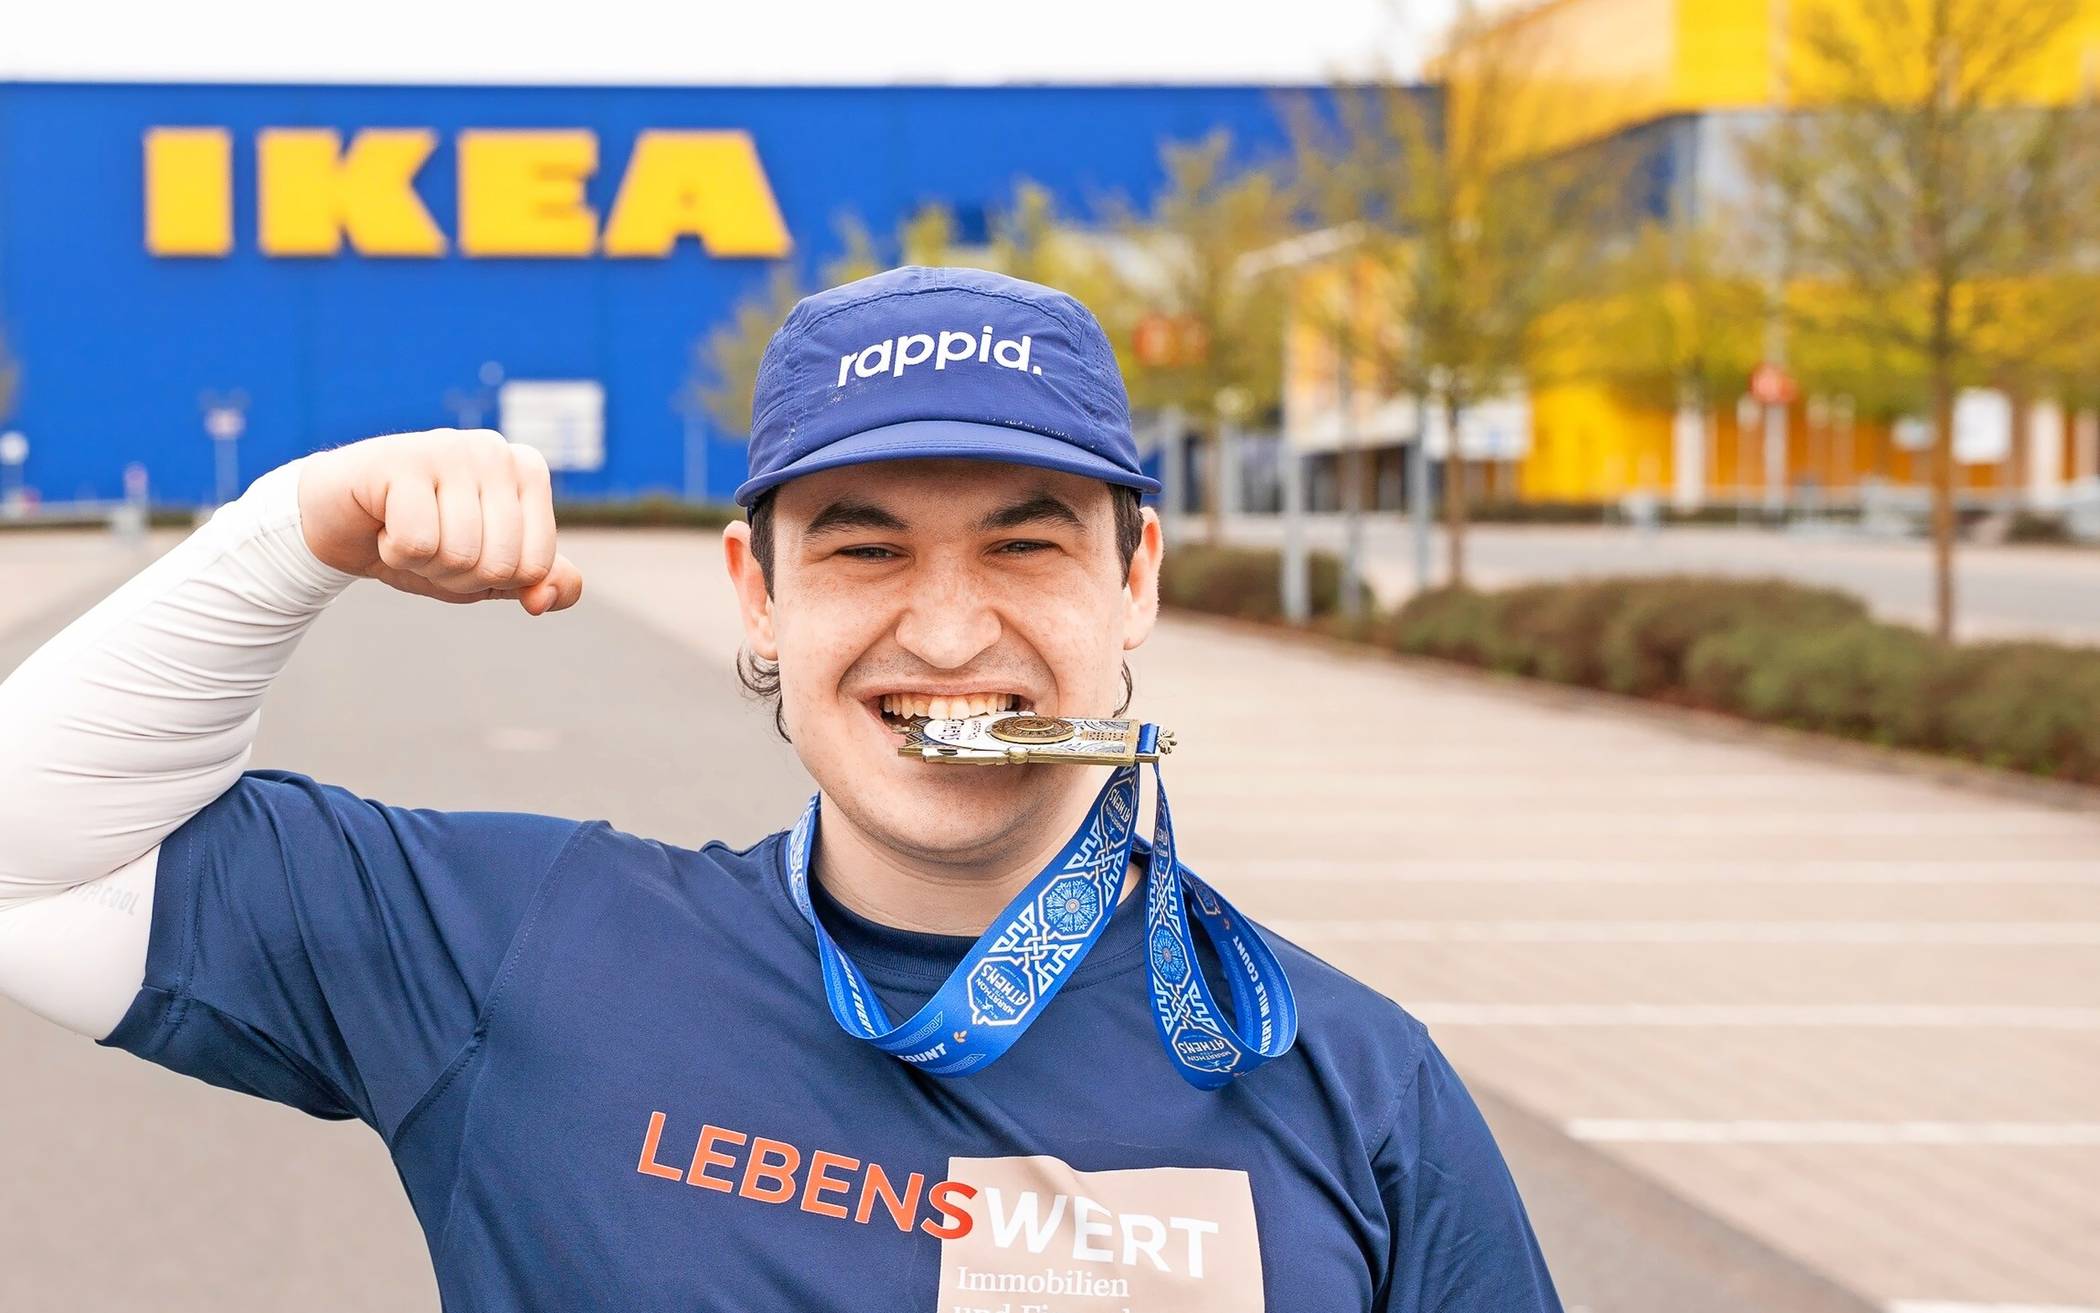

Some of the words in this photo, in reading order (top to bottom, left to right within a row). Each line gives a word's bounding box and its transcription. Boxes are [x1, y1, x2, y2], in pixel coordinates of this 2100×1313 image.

[143, 126, 794, 257] IKEA
[836, 325, 1043, 388] rappid.
[1109, 788, 1132, 822] ATHENS
[1232, 936, 1259, 983] COUNT
[976, 977, 1016, 1015] MARATHON
[981, 964, 1029, 1006] ATHENS
[1255, 982, 1270, 1018] MILE
[1177, 1039, 1225, 1054] ATHENS
[957, 1265, 1130, 1298] Immobilien
